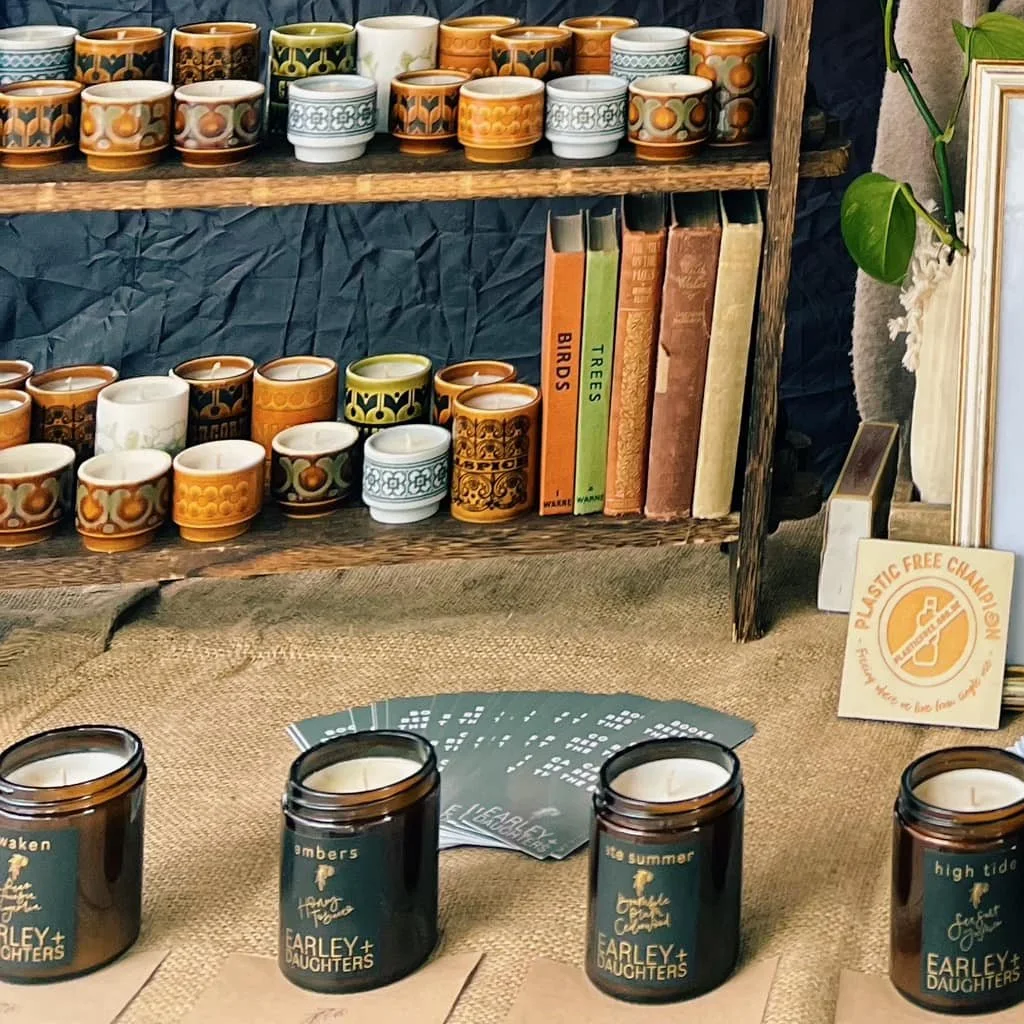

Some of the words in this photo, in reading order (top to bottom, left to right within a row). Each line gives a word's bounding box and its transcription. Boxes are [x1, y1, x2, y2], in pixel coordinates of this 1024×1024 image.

[555, 332, 573, 392] BIRDS
[589, 344, 604, 403] TREES
[855, 563, 902, 630] PLASTIC
[902, 552, 944, 573] FREE
[947, 556, 1001, 641] CHAMPION
[628, 850, 695, 865] summer
[935, 861, 974, 882] high
[984, 859, 1017, 877] tide
[286, 950, 374, 973] DAUGHTERS
[597, 954, 688, 981] DAUGHTERS
[926, 966, 1021, 993] DAUGHTERS
